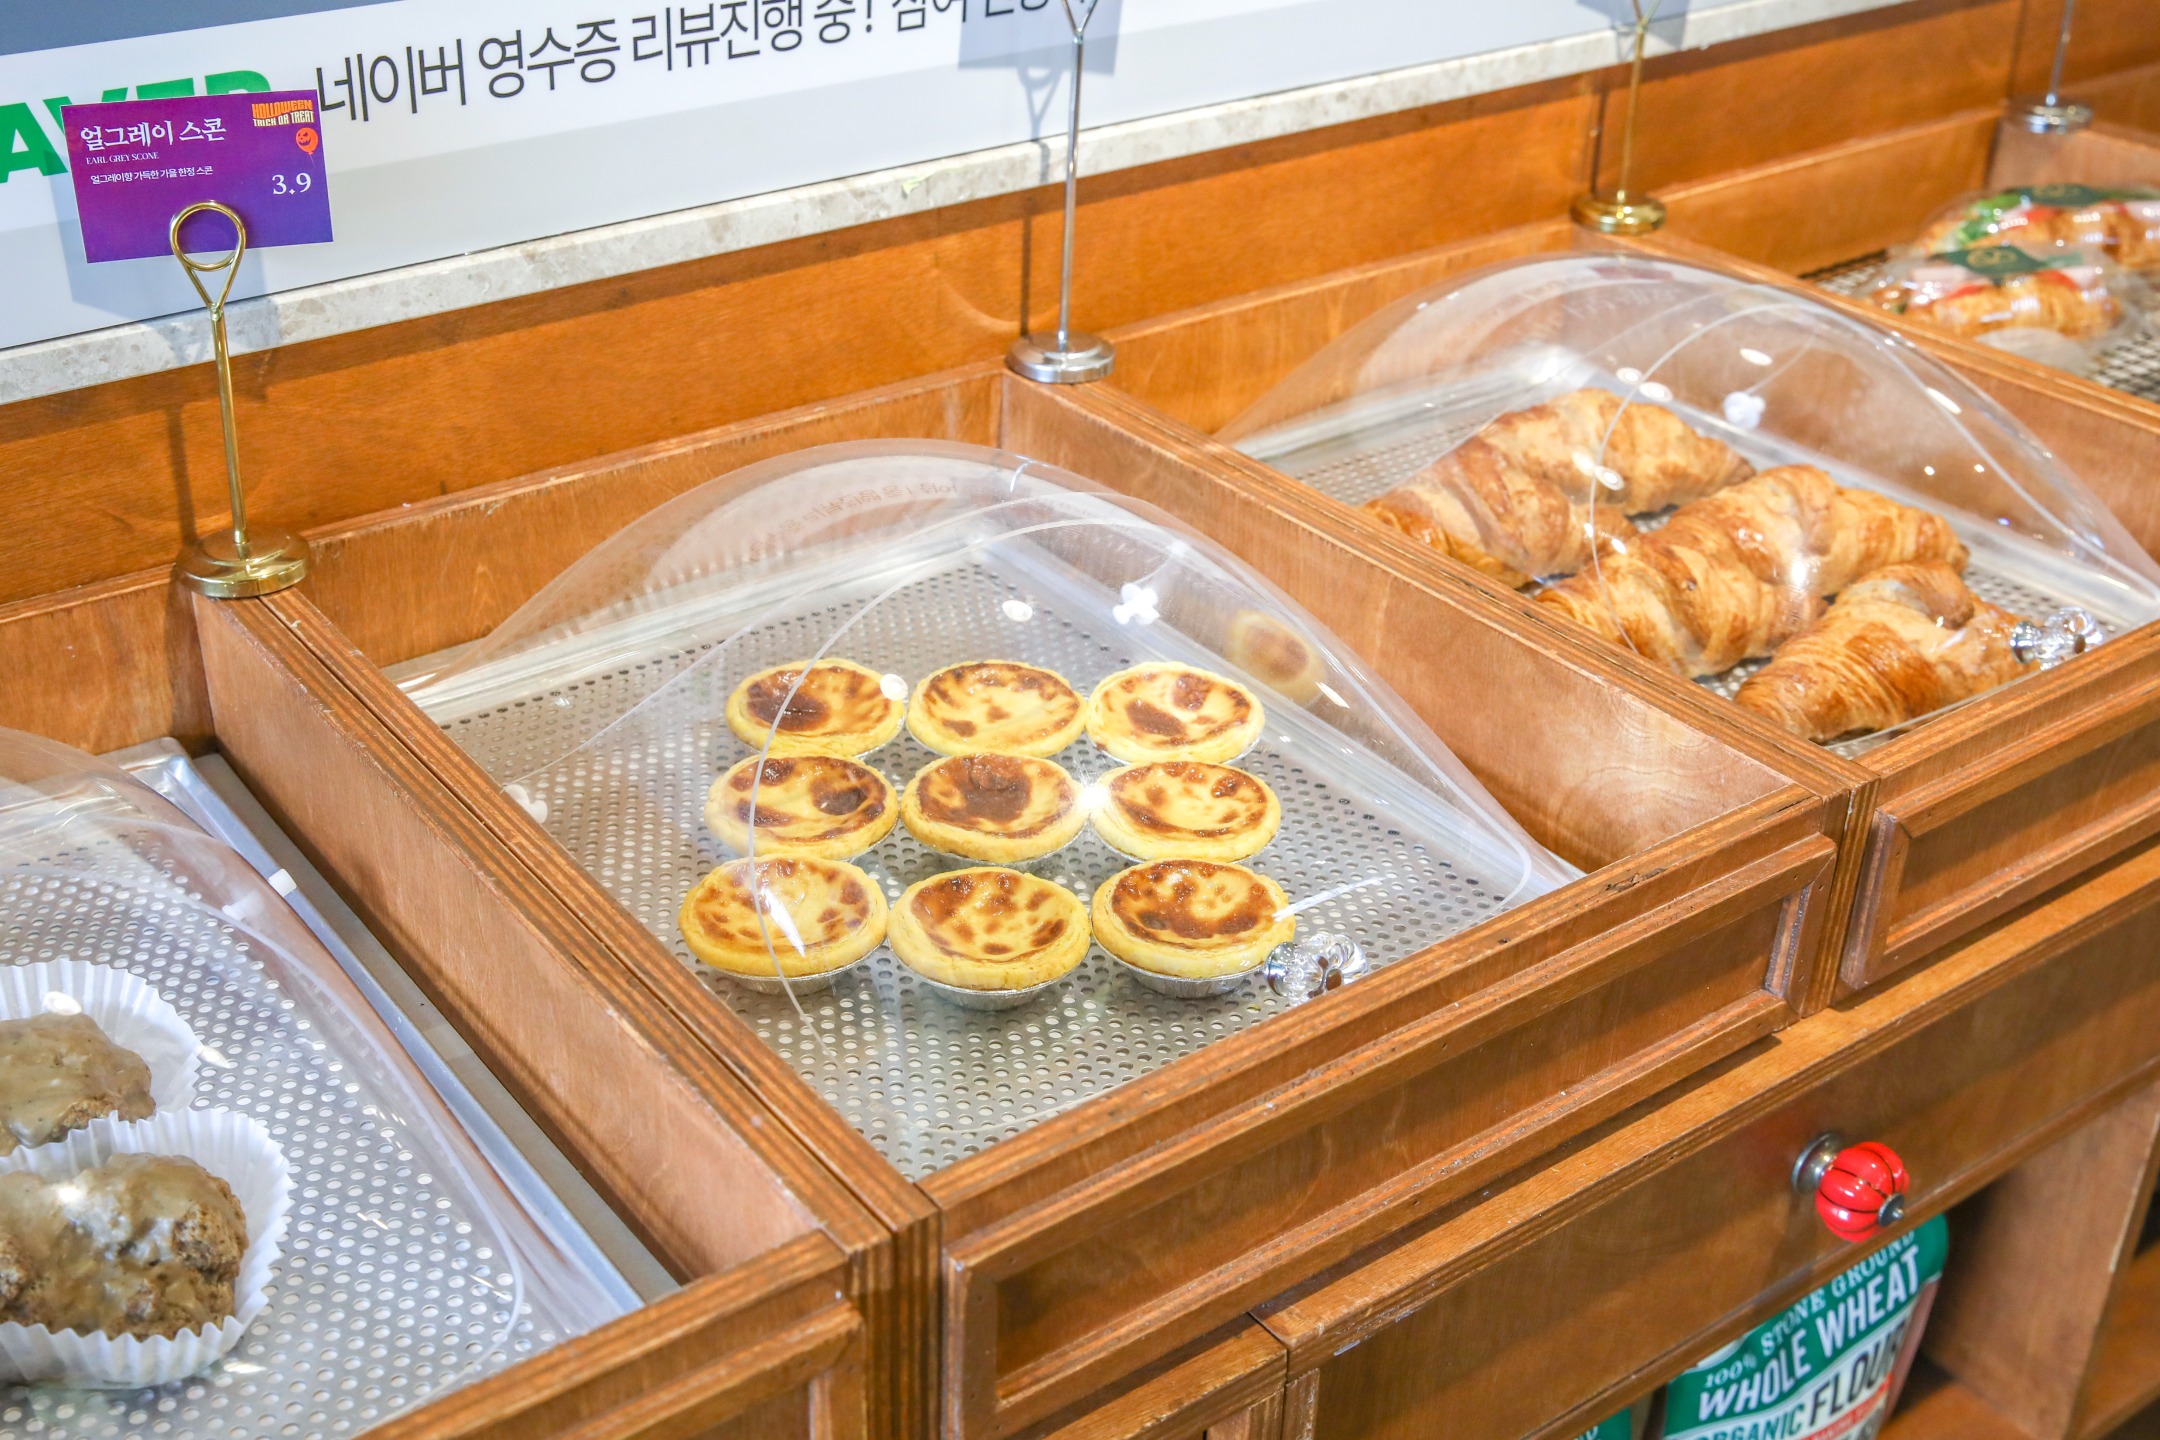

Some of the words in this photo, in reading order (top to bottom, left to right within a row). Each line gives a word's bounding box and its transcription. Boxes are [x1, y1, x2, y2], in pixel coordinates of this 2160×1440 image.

[316, 39, 466, 122] 네이버
[478, 19, 620, 98] 영수증
[632, 0, 802, 71] 리뷰진행
[252, 116, 277, 127] TRICK
[277, 113, 289, 126] OR
[290, 110, 315, 124] TREAT
[80, 120, 174, 151] 얼그레이
[179, 117, 227, 142] 스콘
[86, 156, 108, 165] EARL
[109, 153, 130, 163] GREY
[131, 151, 160, 161] SCONE
[90, 171, 133, 185] 얼그레이향
[134, 169, 160, 181] 가득한
[160, 167, 178, 178] 가을
[178, 166, 195, 177] 한정
[196, 165, 214, 175] 스콘
[271, 172, 312, 195] 3.9
[1698, 1328, 1811, 1422] WHOLE
[1815, 1244, 1919, 1358] WHEAT
[1761, 1287, 1826, 1356] STONE
